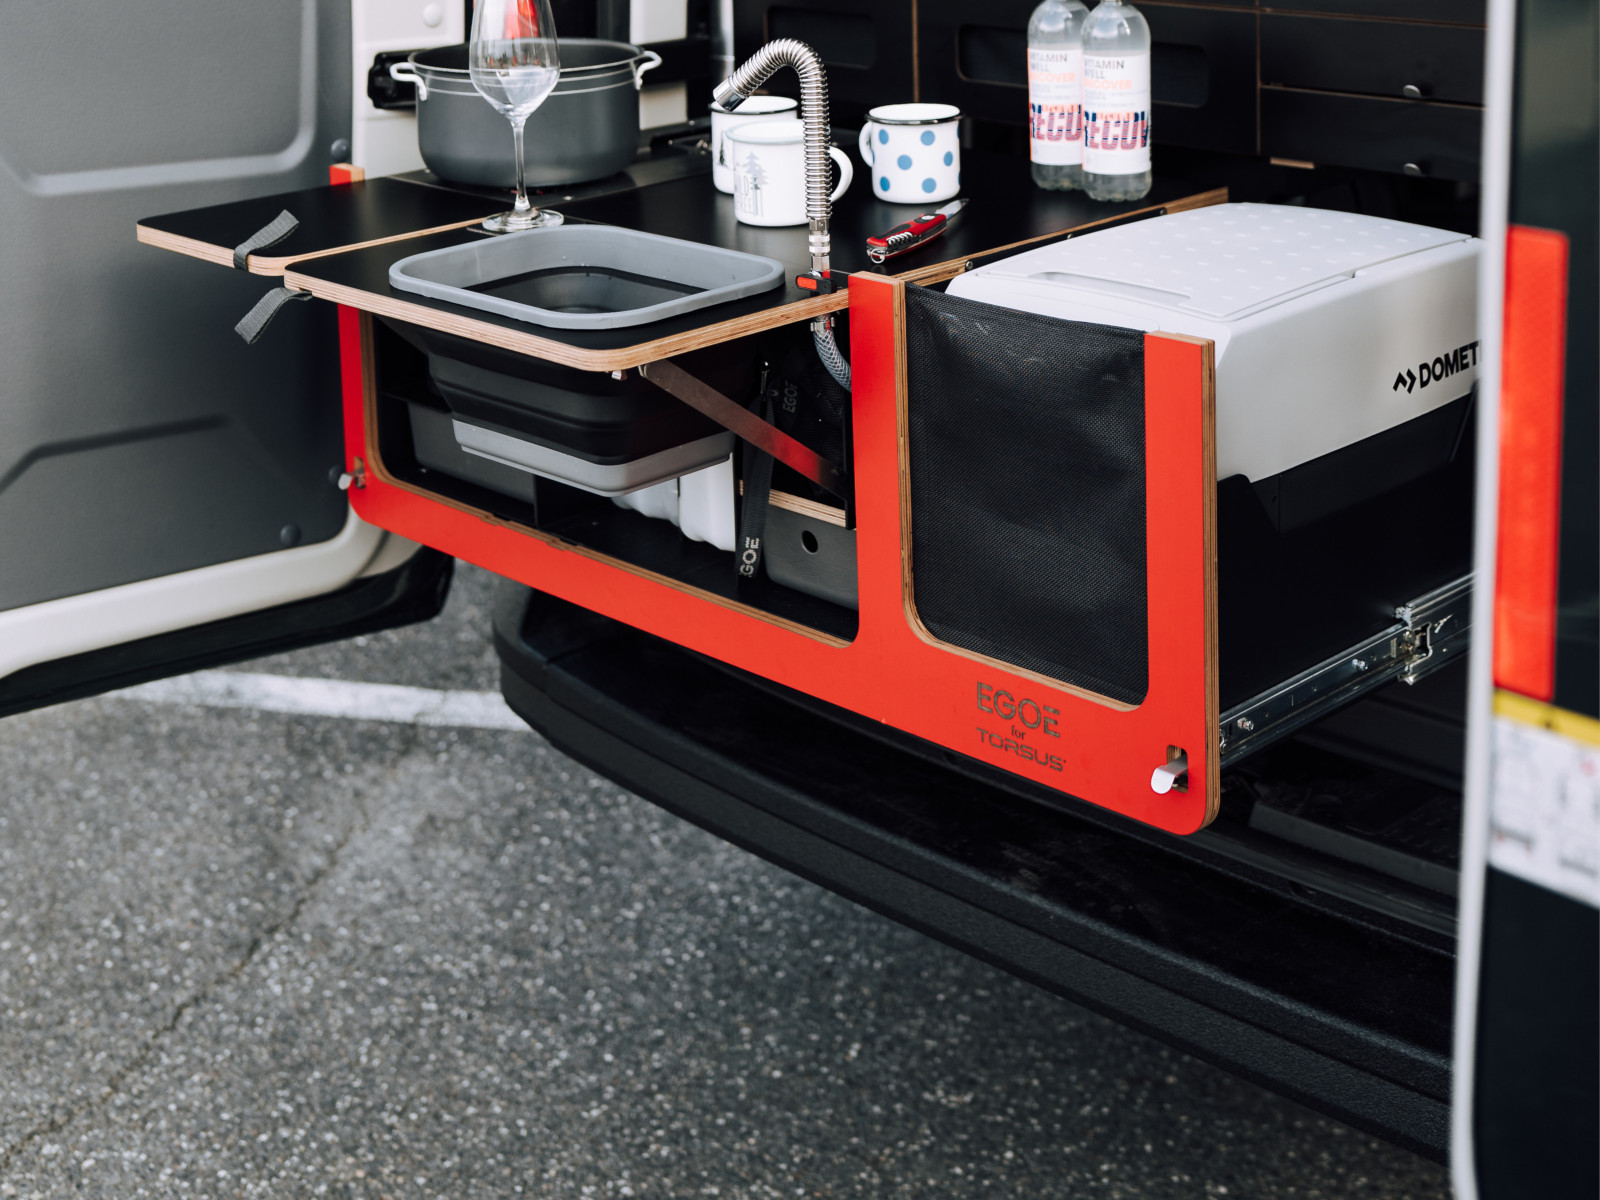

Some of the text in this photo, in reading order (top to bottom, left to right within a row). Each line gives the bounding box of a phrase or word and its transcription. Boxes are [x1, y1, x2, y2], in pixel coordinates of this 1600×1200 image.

[1419, 340, 1480, 389] DOMET
[976, 726, 1064, 772] TORSUS
[1011, 725, 1027, 740] for
